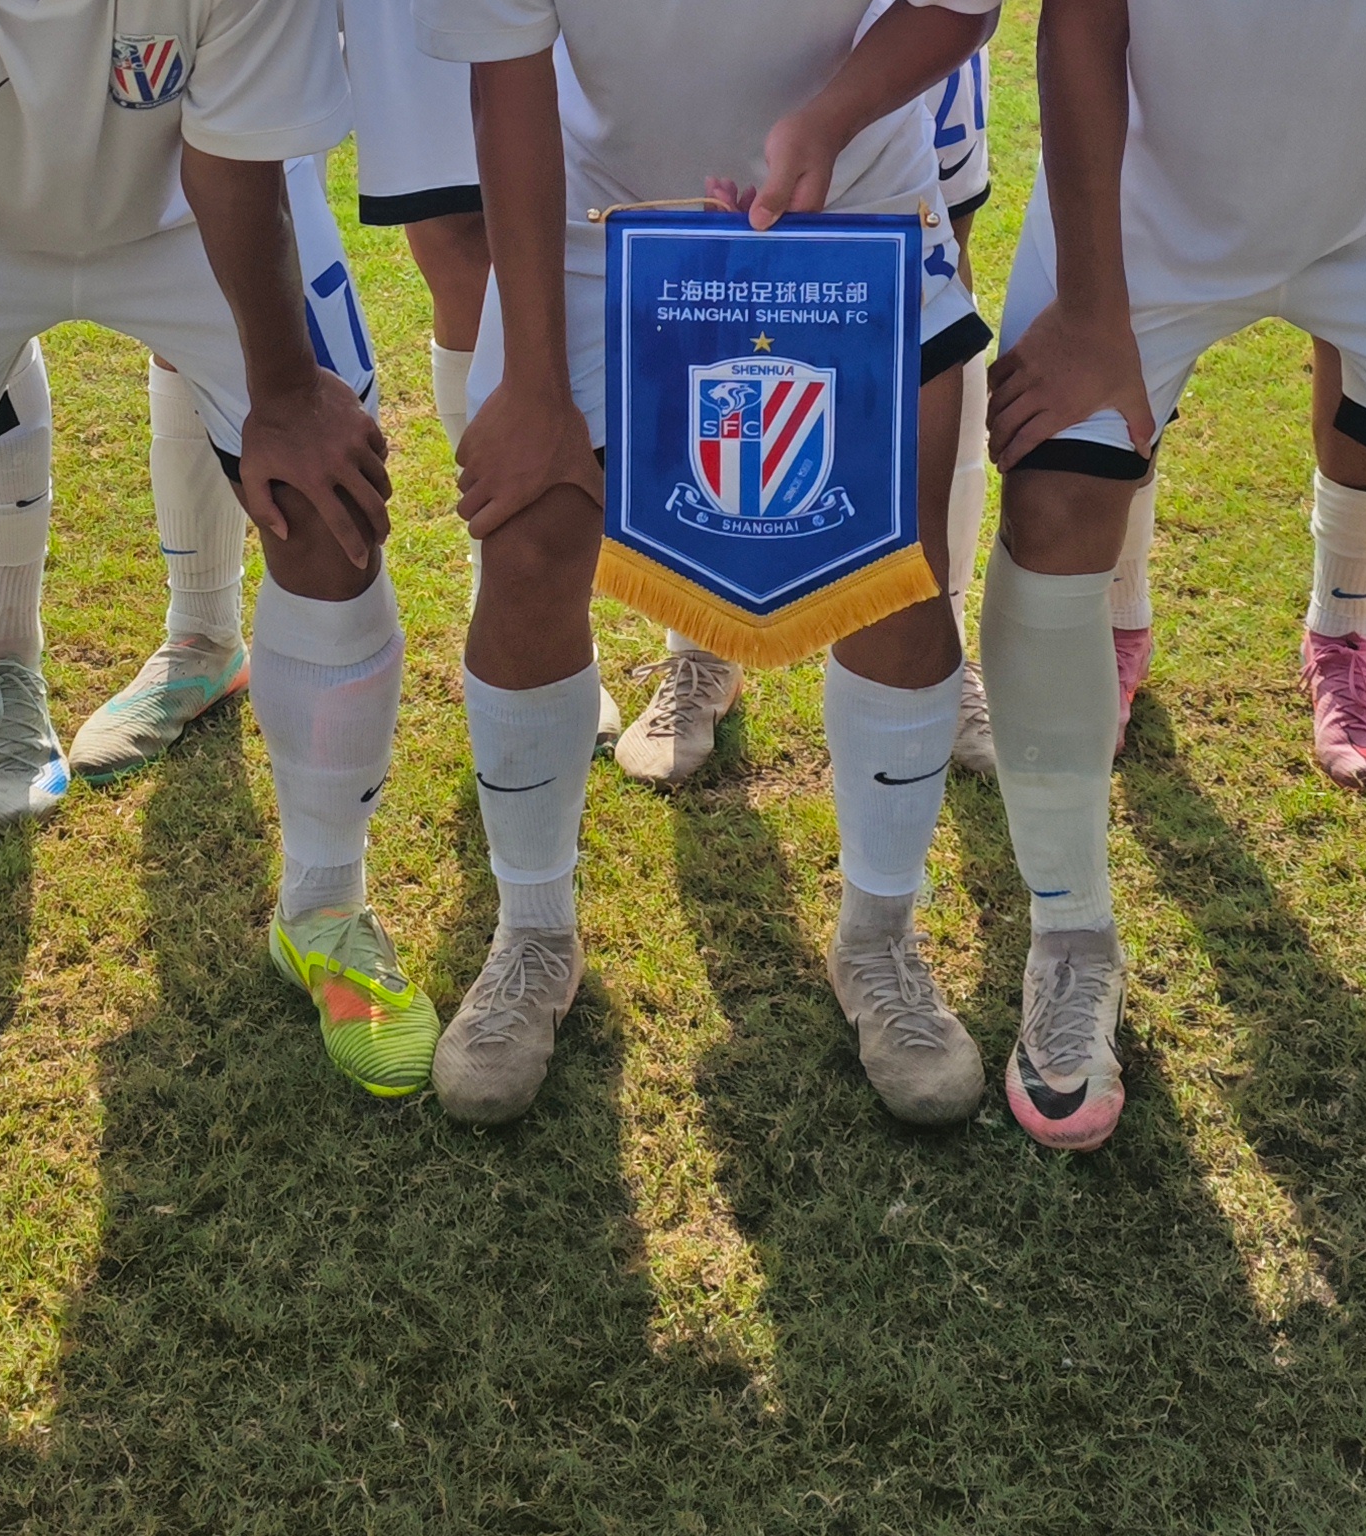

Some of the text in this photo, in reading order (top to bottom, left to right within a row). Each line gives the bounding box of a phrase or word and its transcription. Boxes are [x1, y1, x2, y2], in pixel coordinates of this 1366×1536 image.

[656, 278, 868, 304] 上海申花足球俱乐部
[656, 306, 869, 325] SHANGHAI SHENHUA FC
[731, 364, 795, 376] SHENHUA
[702, 420, 760, 436] SFC
[722, 518, 799, 534] SHANGHAI
